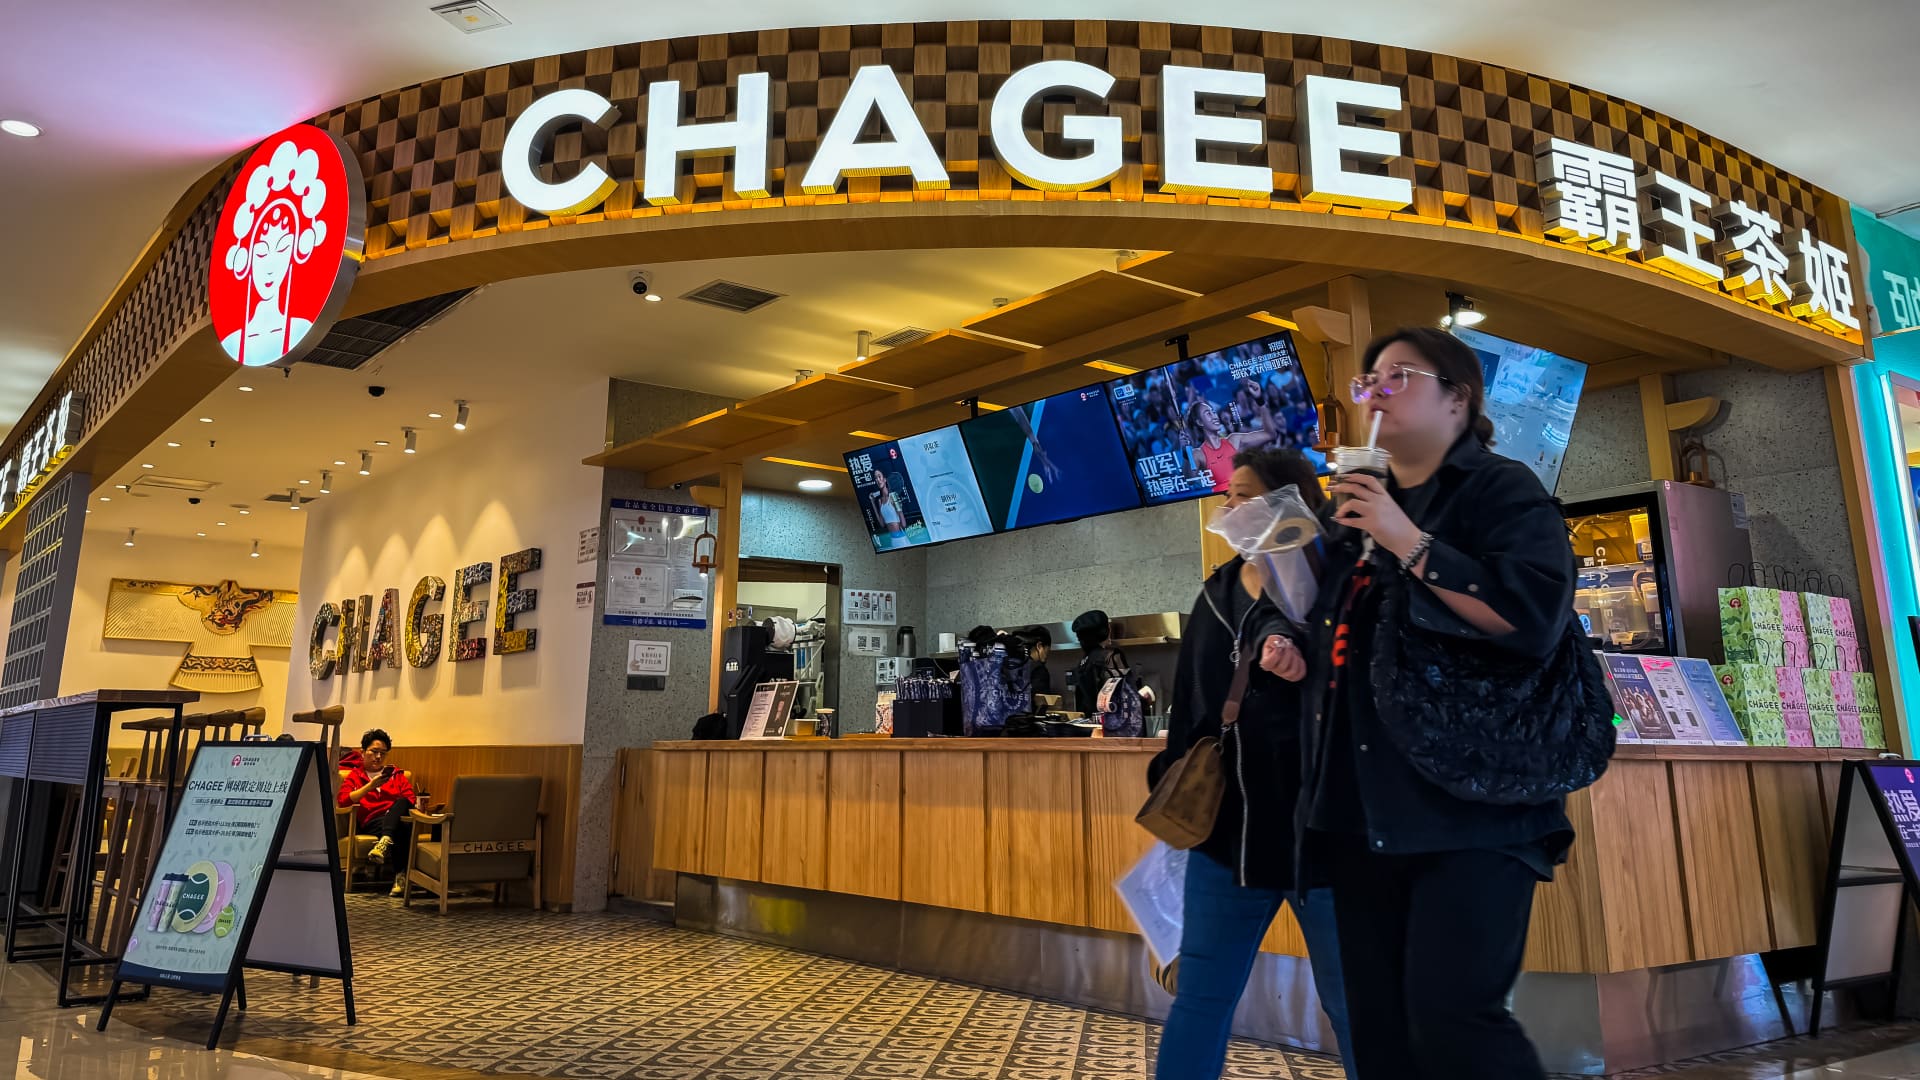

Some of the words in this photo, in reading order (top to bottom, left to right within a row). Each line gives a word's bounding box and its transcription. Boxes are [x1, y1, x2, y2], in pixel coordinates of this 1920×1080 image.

[501, 60, 1413, 212] CHAGEE
[1551, 137, 1860, 330] 霸王茶姬
[1229, 357, 1258, 371] CHAGEE
[1138, 451, 1182, 480] 亚军!
[1146, 469, 1216, 498] 热爱在一起
[309, 547, 542, 680] CHAGEE
[1754, 621, 1780, 631] CHAGEE
[1748, 700, 1779, 710] CHAGEE
[188, 780, 224, 791] CHAGEE
[224, 778, 288, 794] 网球限定周边上线
[1883, 789, 1920, 822] 热爱
[463, 841, 525, 853] CHAGEE
